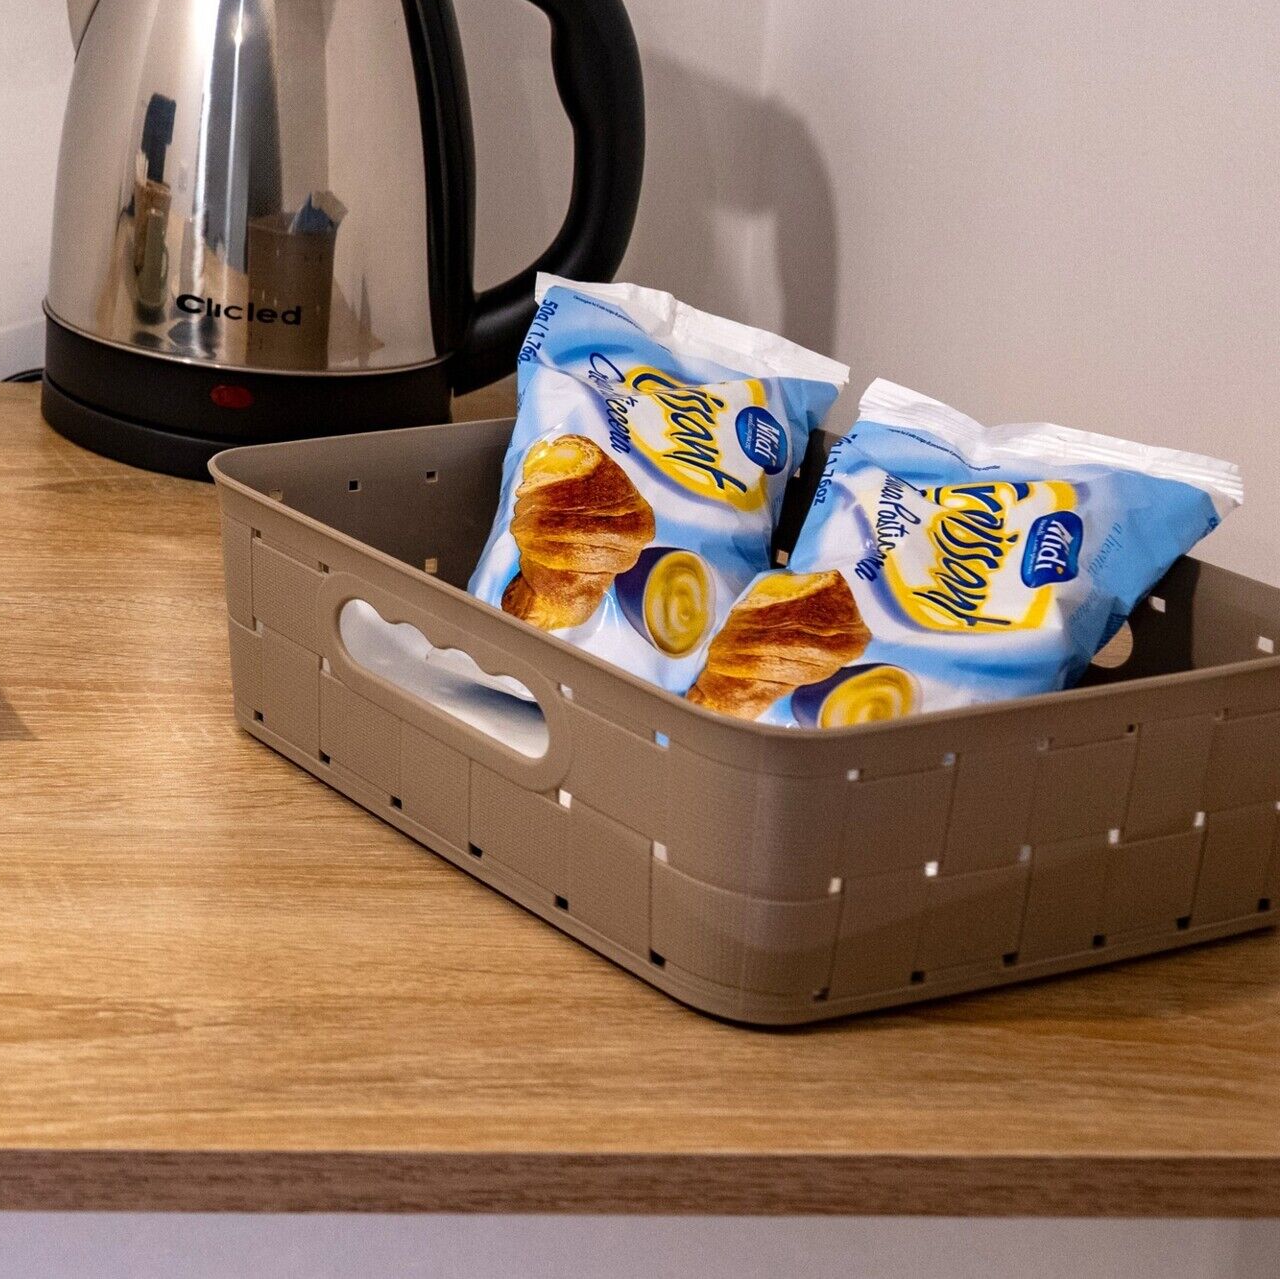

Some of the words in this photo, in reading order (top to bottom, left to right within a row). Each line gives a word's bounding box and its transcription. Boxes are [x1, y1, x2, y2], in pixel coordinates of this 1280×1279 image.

[176, 294, 302, 325] Clicled
[518, 330, 546, 364] 1.76o
[1035, 520, 1074, 575] Midi
